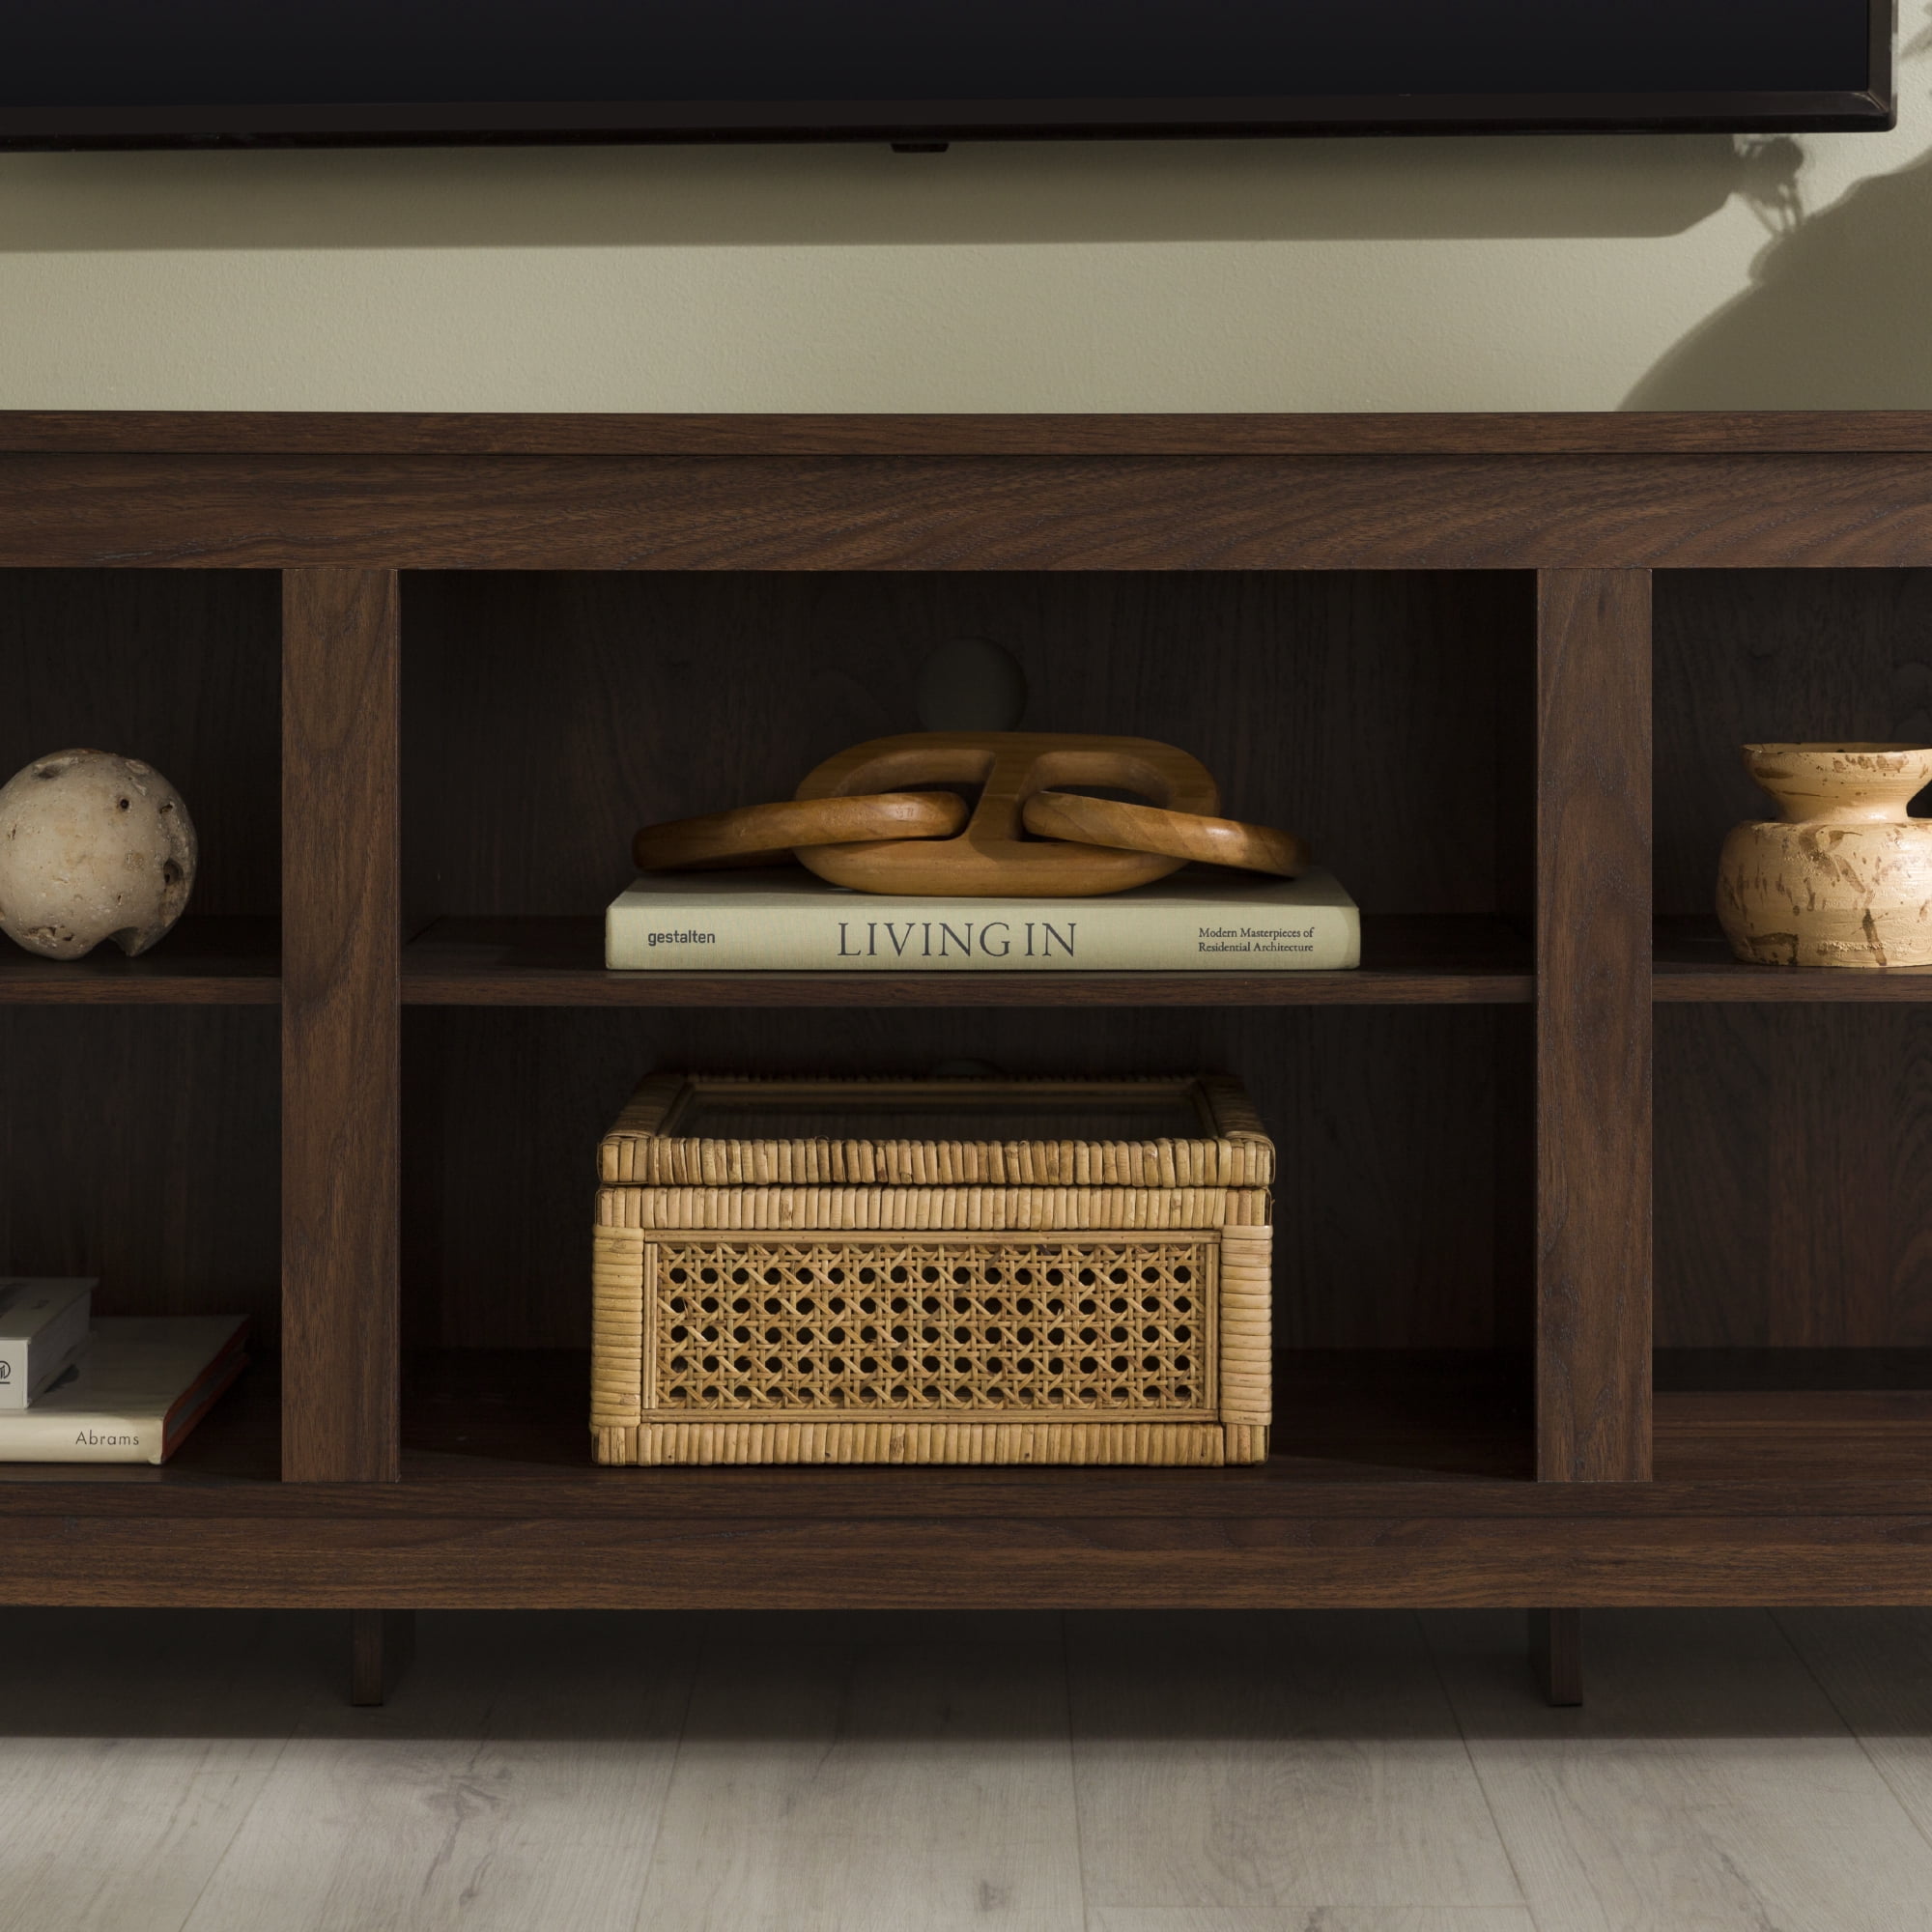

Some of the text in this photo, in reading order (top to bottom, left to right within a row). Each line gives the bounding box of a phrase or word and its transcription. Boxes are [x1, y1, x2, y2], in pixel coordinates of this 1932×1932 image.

[647, 929, 716, 947] gestalten
[1198, 926, 1315, 941] Modern Masterpieces of
[1198, 941, 1314, 952] Residential Architecture
[75, 1430, 139, 1446] Abrams
